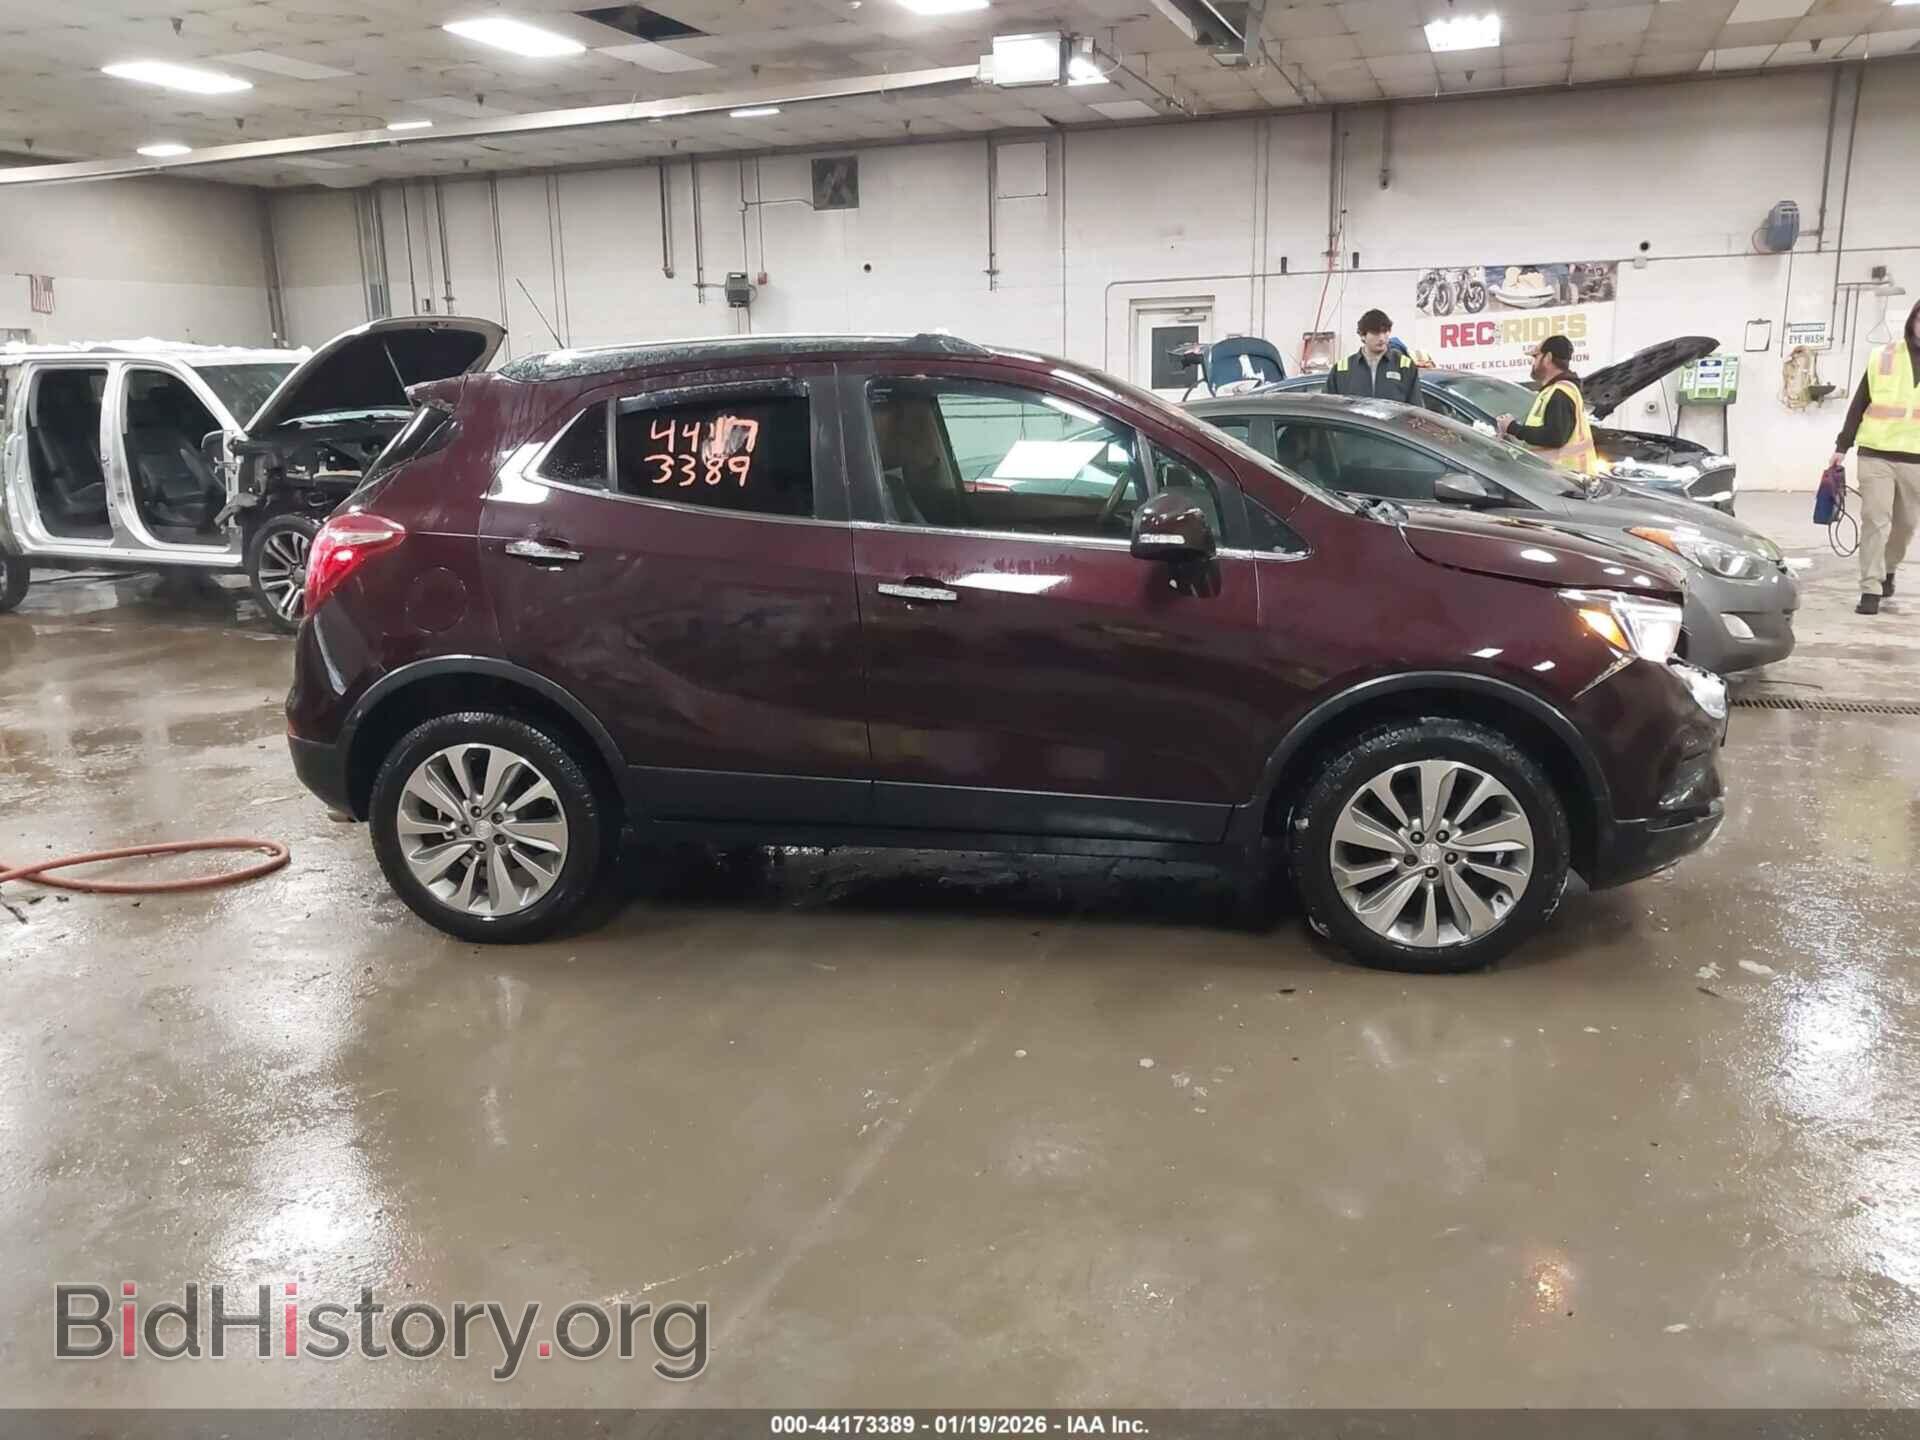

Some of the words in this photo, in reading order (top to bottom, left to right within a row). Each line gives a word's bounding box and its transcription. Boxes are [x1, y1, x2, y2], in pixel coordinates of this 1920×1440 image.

[1440, 321, 1495, 348] REC
[1503, 313, 1585, 343] RIDES
[1789, 335, 1802, 344] EYE
[1804, 334, 1824, 344] WASH
[643, 454, 750, 487] 3389
